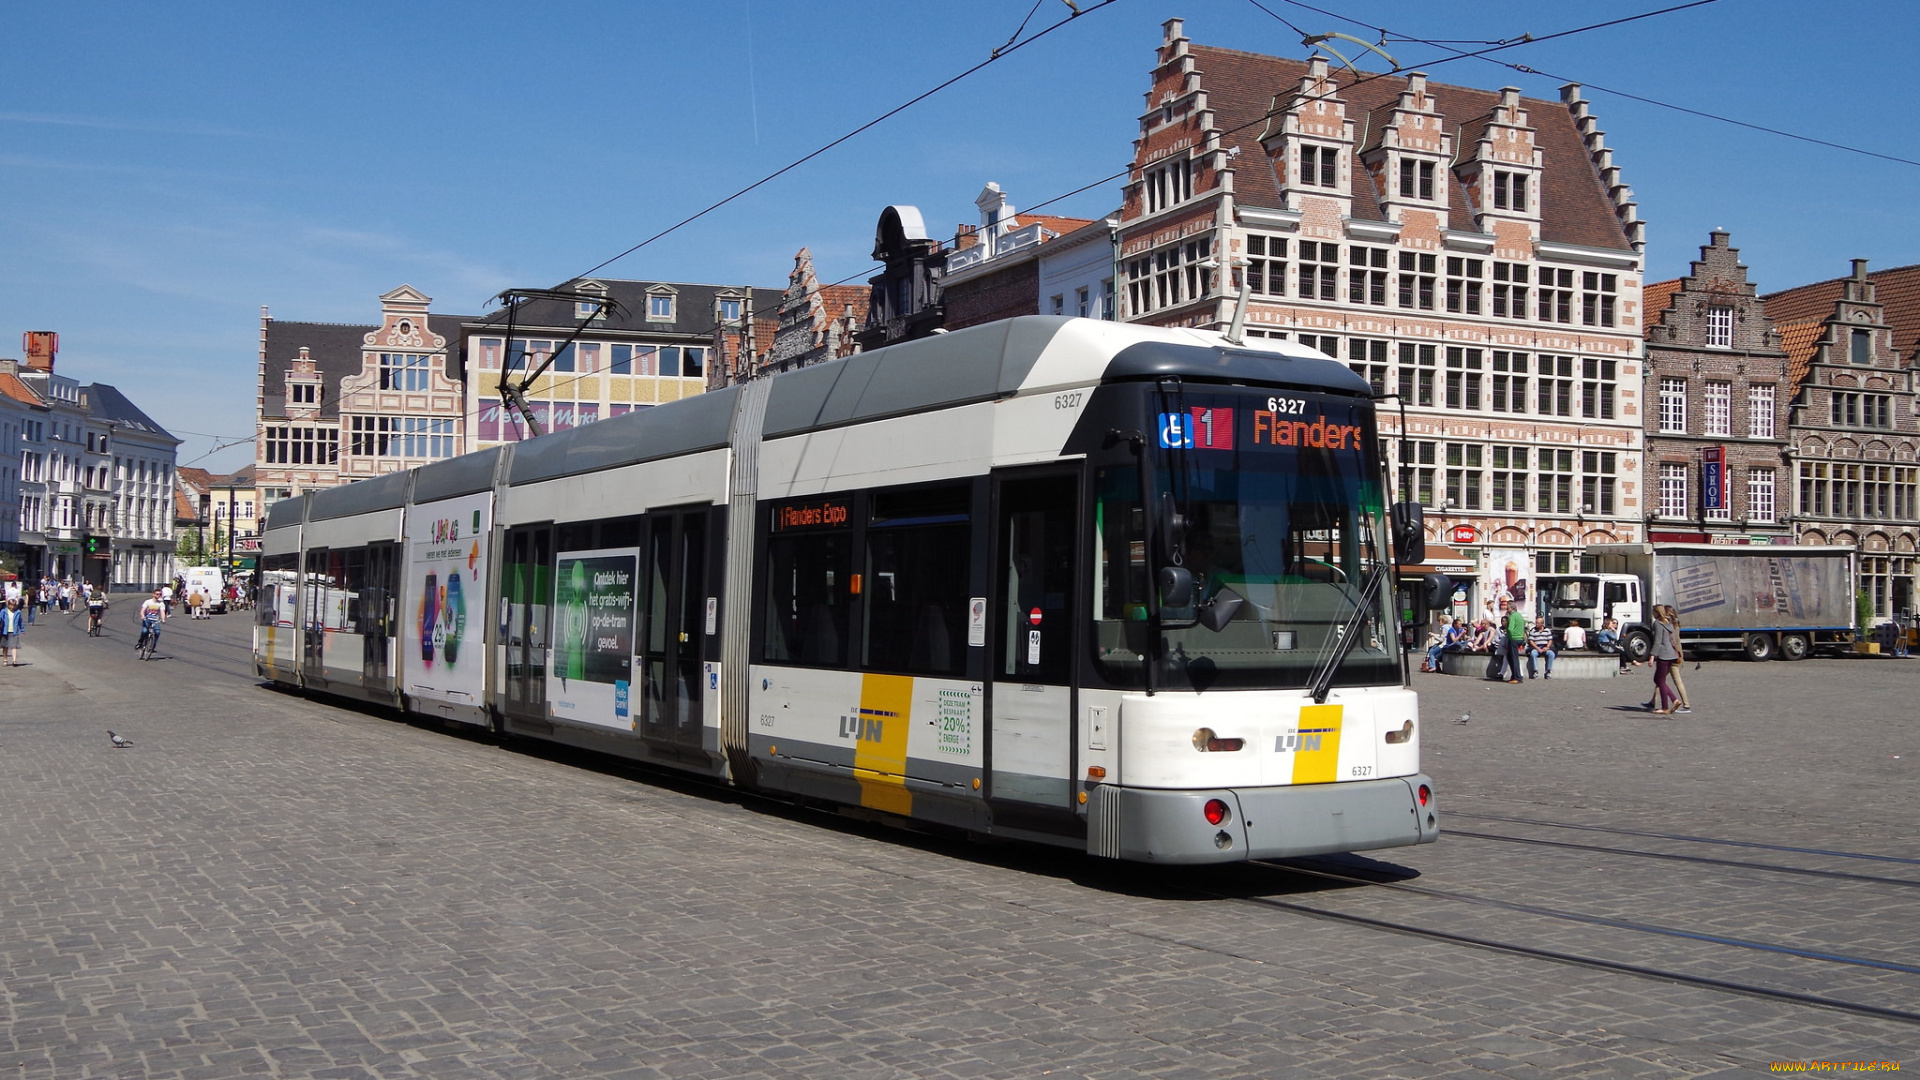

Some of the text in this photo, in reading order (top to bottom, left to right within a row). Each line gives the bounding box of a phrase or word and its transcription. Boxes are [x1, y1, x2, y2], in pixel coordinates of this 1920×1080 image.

[1055, 393, 1082, 410] 6327
[1267, 397, 1306, 415] 6327
[1201, 409, 1361, 450] 1 Flanders
[1708, 464, 1717, 507] SHOP
[785, 505, 821, 526] Flanders
[823, 503, 847, 526] Expo
[431, 521, 435, 545] 1
[449, 519, 459, 543] 4G
[594, 570, 629, 586] Ontdek hier
[1767, 558, 1791, 617] Jupiler
[589, 592, 599, 606] het
[592, 612, 627, 631] op-de-tram
[597, 635, 619, 652] gevoel.
[943, 708, 966, 716] BESPAART
[953, 700, 966, 708] TRAM
[760, 714, 775, 727] 6327
[839, 715, 883, 743] LIJN
[943, 716, 966, 733] 20%
[943, 733, 960, 744] ENERGIE
[1274, 734, 1322, 753] LIJN
[1352, 766, 1372, 776] 6327
